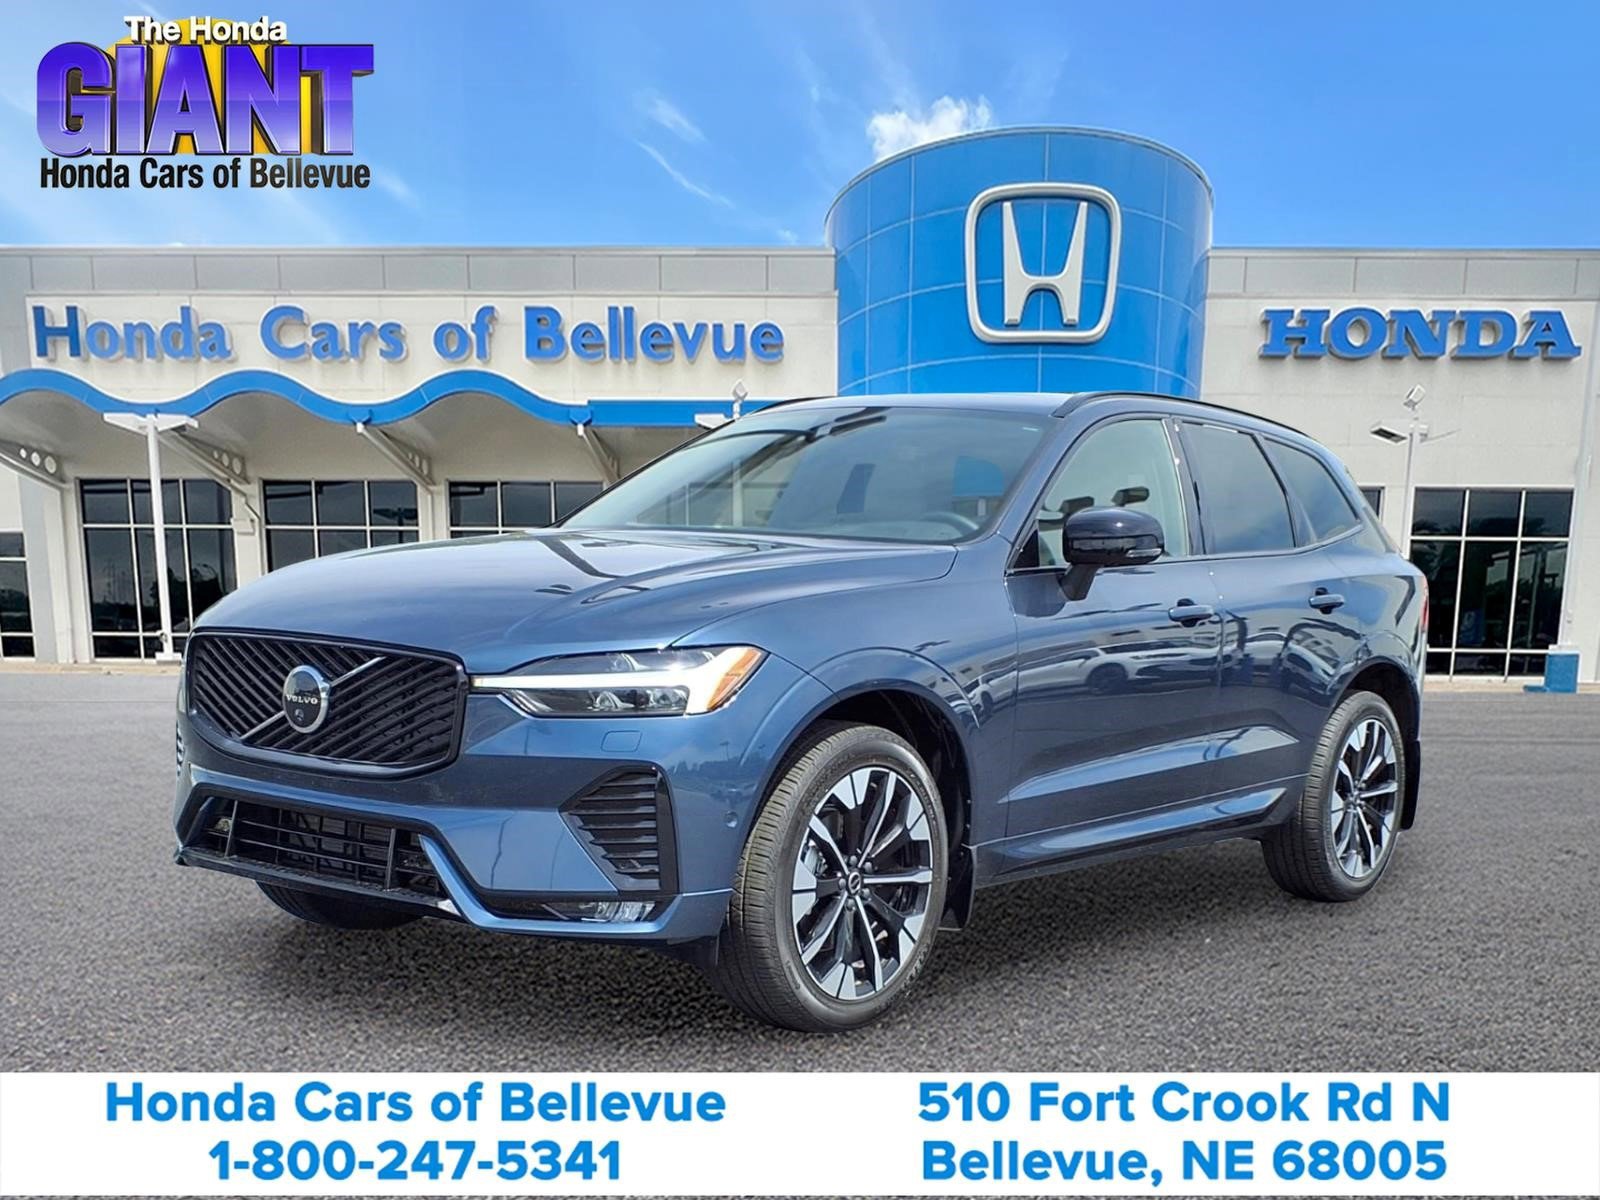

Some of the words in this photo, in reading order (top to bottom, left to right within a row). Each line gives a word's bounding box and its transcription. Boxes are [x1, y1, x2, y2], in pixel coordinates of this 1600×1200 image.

[32, 305, 233, 361] Honda
[260, 305, 407, 361] Cars
[433, 305, 498, 361] of
[524, 305, 785, 363] Bellevue
[1259, 307, 1582, 360] HONDA
[286, 694, 319, 705] VOLVO
